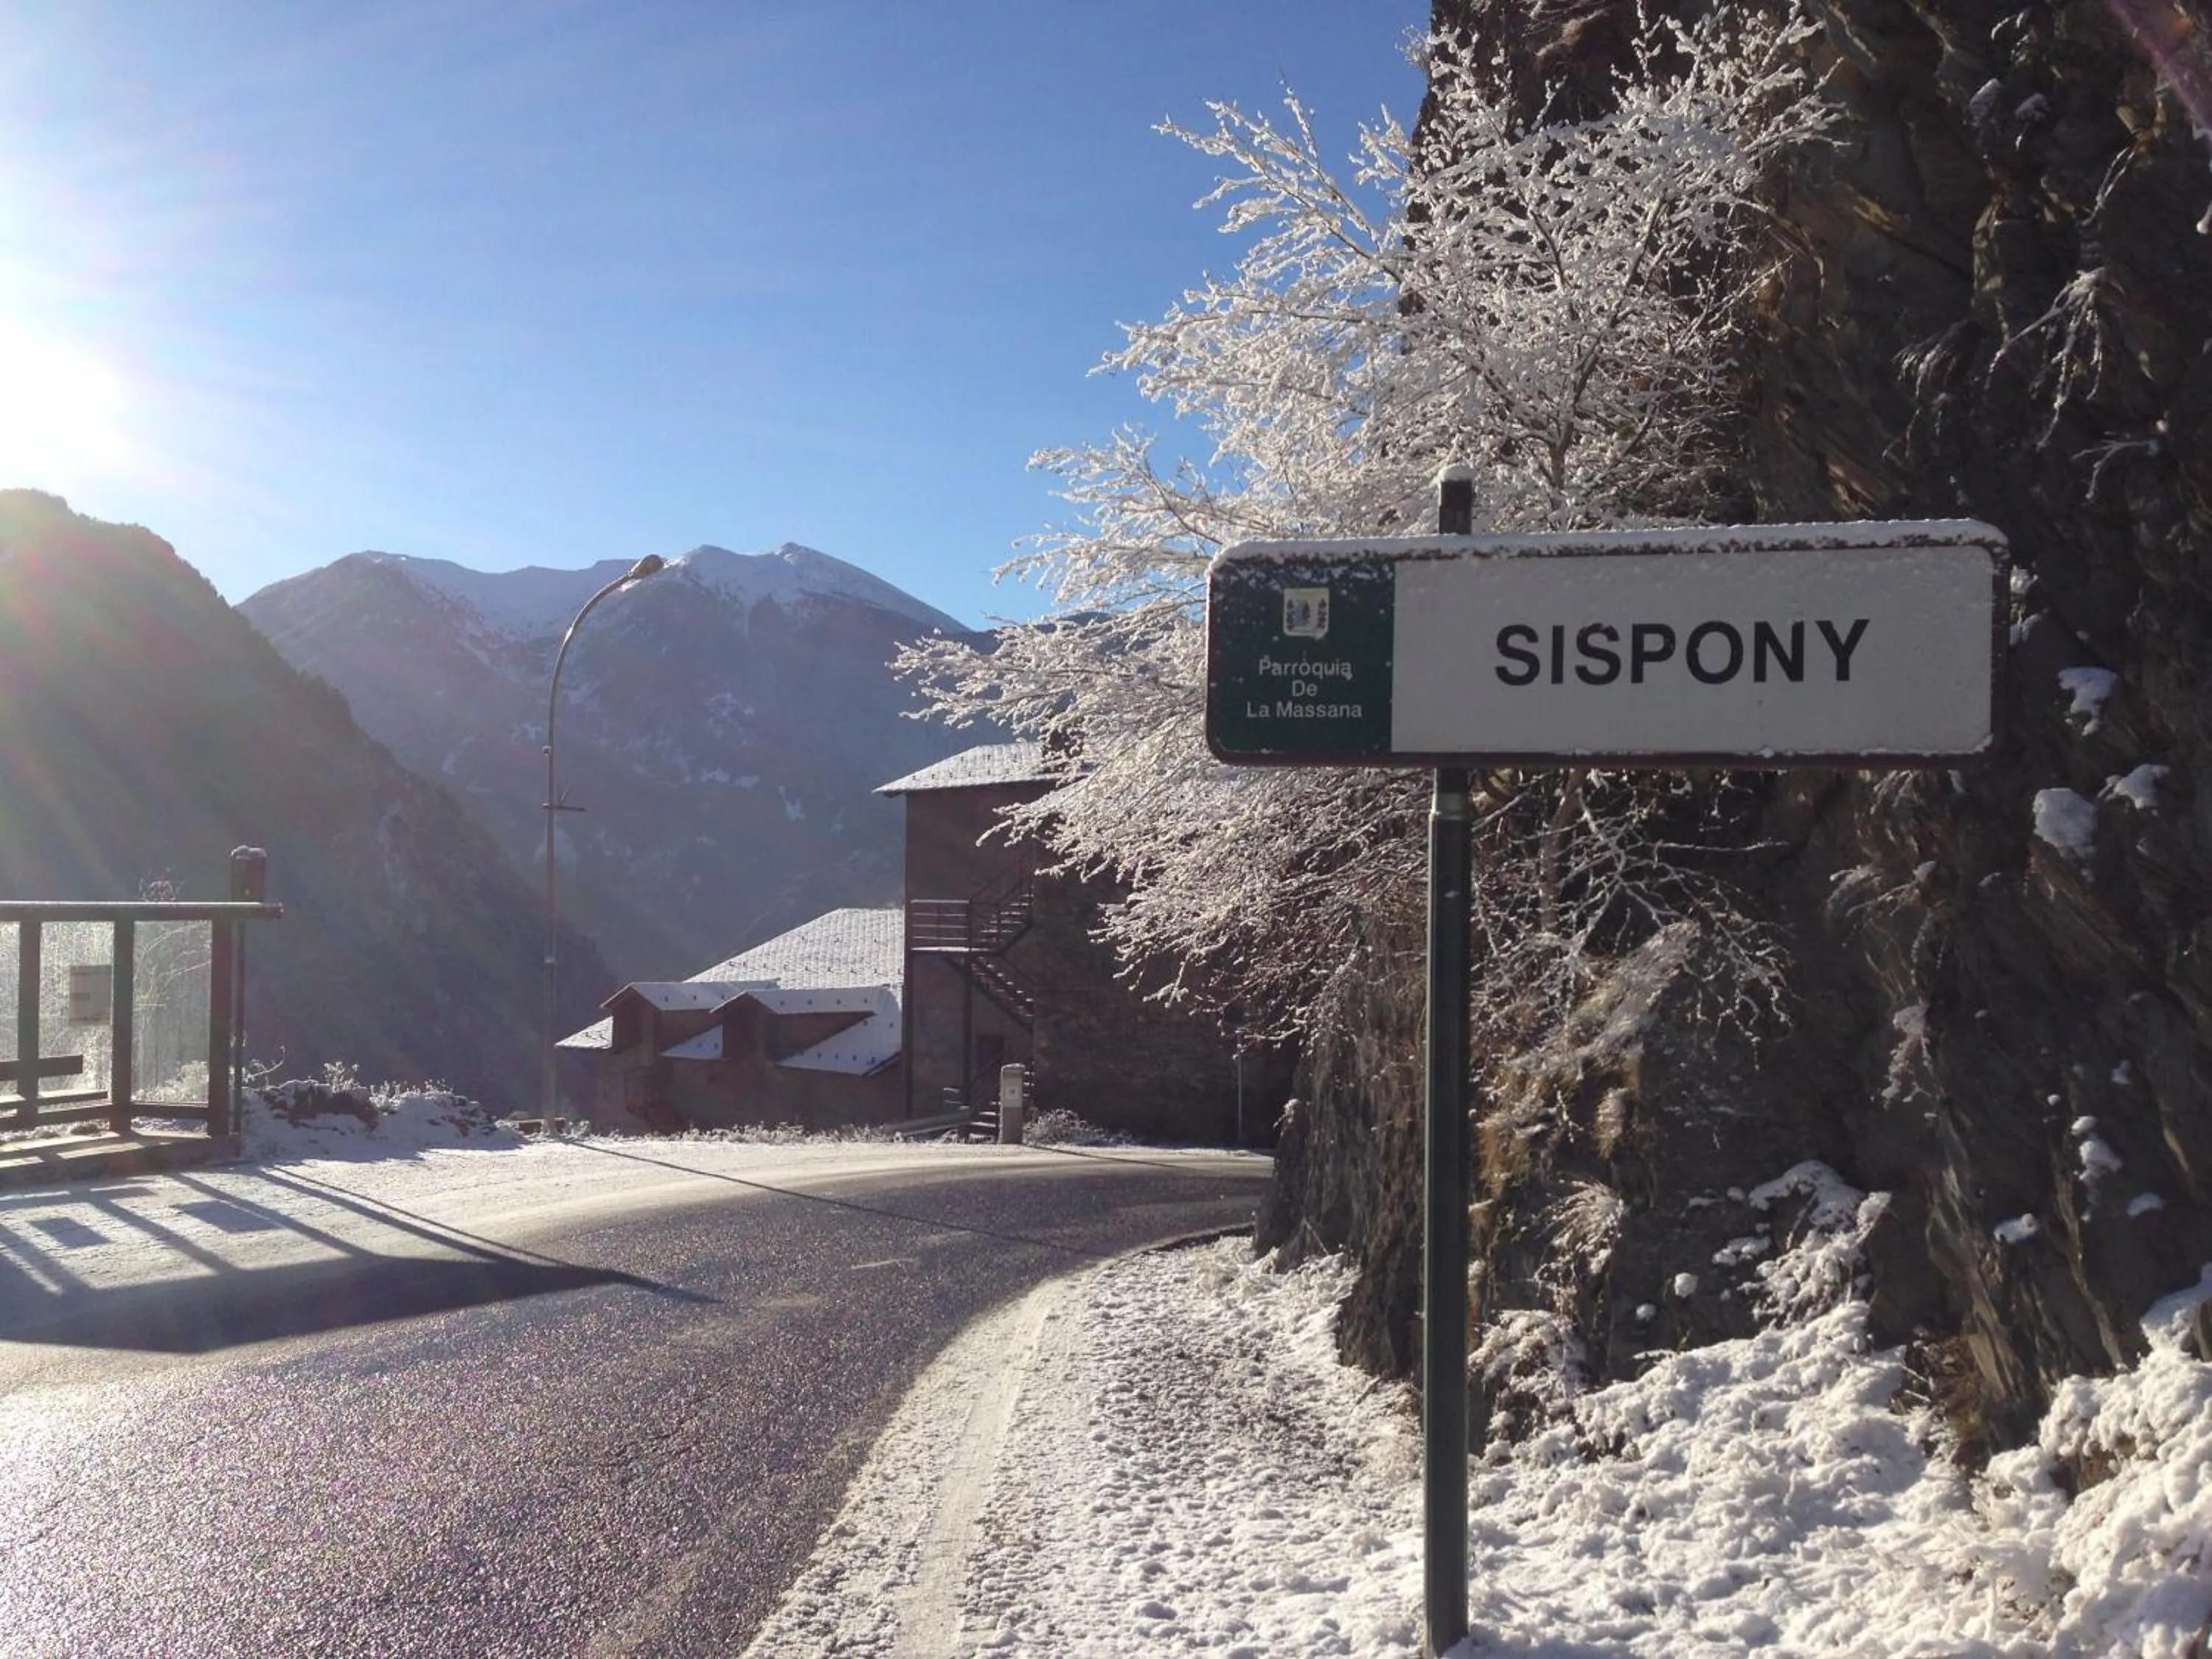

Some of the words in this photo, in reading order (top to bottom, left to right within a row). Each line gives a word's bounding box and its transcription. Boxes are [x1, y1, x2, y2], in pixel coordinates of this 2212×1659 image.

[1495, 619, 1870, 686] SISPONY
[1292, 680, 1318, 697] De
[1246, 701, 1270, 718] La
[1277, 701, 1363, 718] Massana
